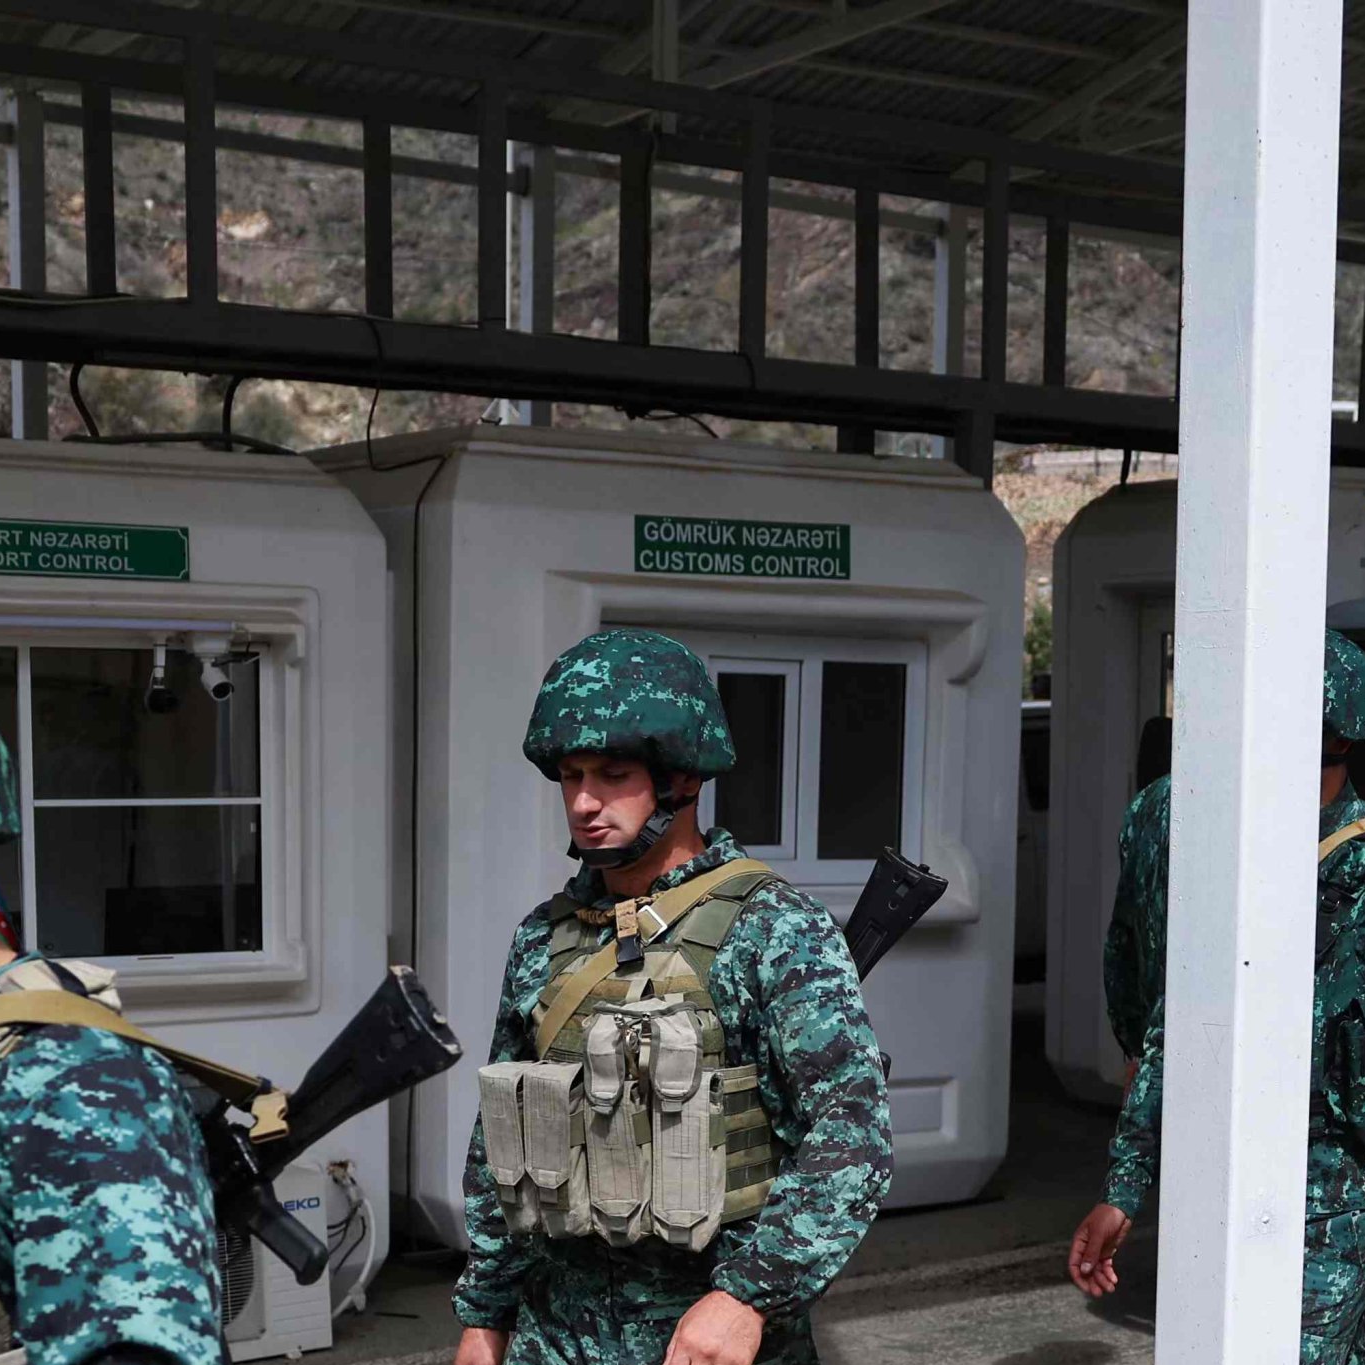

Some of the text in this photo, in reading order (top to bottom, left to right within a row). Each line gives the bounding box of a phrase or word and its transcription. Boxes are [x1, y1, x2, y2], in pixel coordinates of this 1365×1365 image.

[29, 530, 130, 551] NƏZARƏTİ
[643, 518, 841, 549] GÖMRÜK NƏZARƏTİ
[37, 553, 135, 572] CONTROL
[639, 549, 846, 577] CUSTOMS CONTROL
